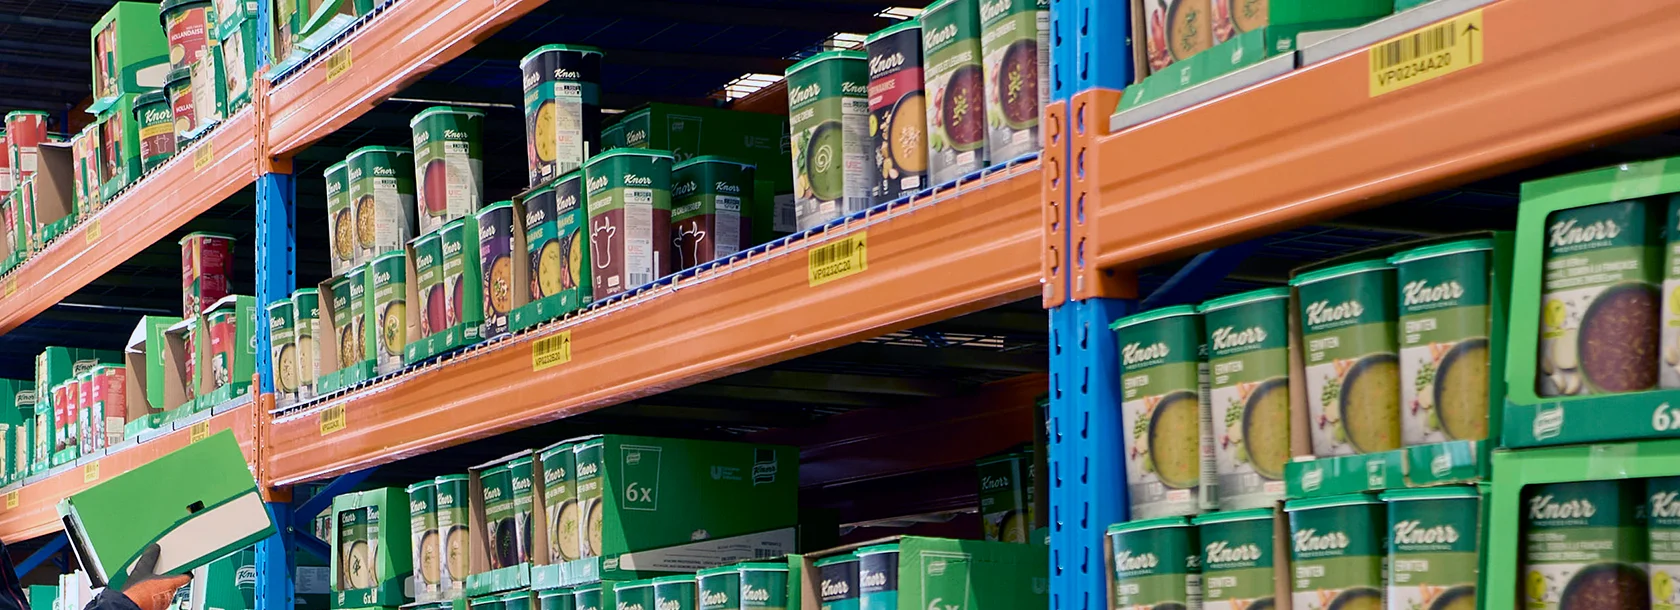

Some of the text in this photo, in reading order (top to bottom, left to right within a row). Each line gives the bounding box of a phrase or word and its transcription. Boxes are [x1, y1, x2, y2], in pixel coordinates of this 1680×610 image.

[924, 24, 958, 51] Knorr
[869, 52, 905, 77] Knorr
[1378, 51, 1452, 86] VP0234A20
[789, 83, 821, 107] Knorr
[624, 174, 652, 185] Knorr
[715, 181, 740, 192] Knorr
[1549, 218, 1620, 248] Knorr
[1402, 279, 1463, 306] Knorr
[1306, 299, 1364, 325] Knorr
[1212, 326, 1267, 351] Knorr
[1121, 342, 1170, 366] Knorr
[626, 482, 652, 503] 6x
[981, 474, 1010, 490] Knorr
[1528, 495, 1597, 519] Knorr
[1295, 529, 1350, 552] Knorr
[1394, 521, 1459, 545] Knorr
[1115, 551, 1158, 572] Knorr
[1205, 541, 1262, 563] Knorr
[701, 590, 729, 606] Knorr
[743, 583, 769, 602] Knorr
[822, 580, 850, 598] Knorr
